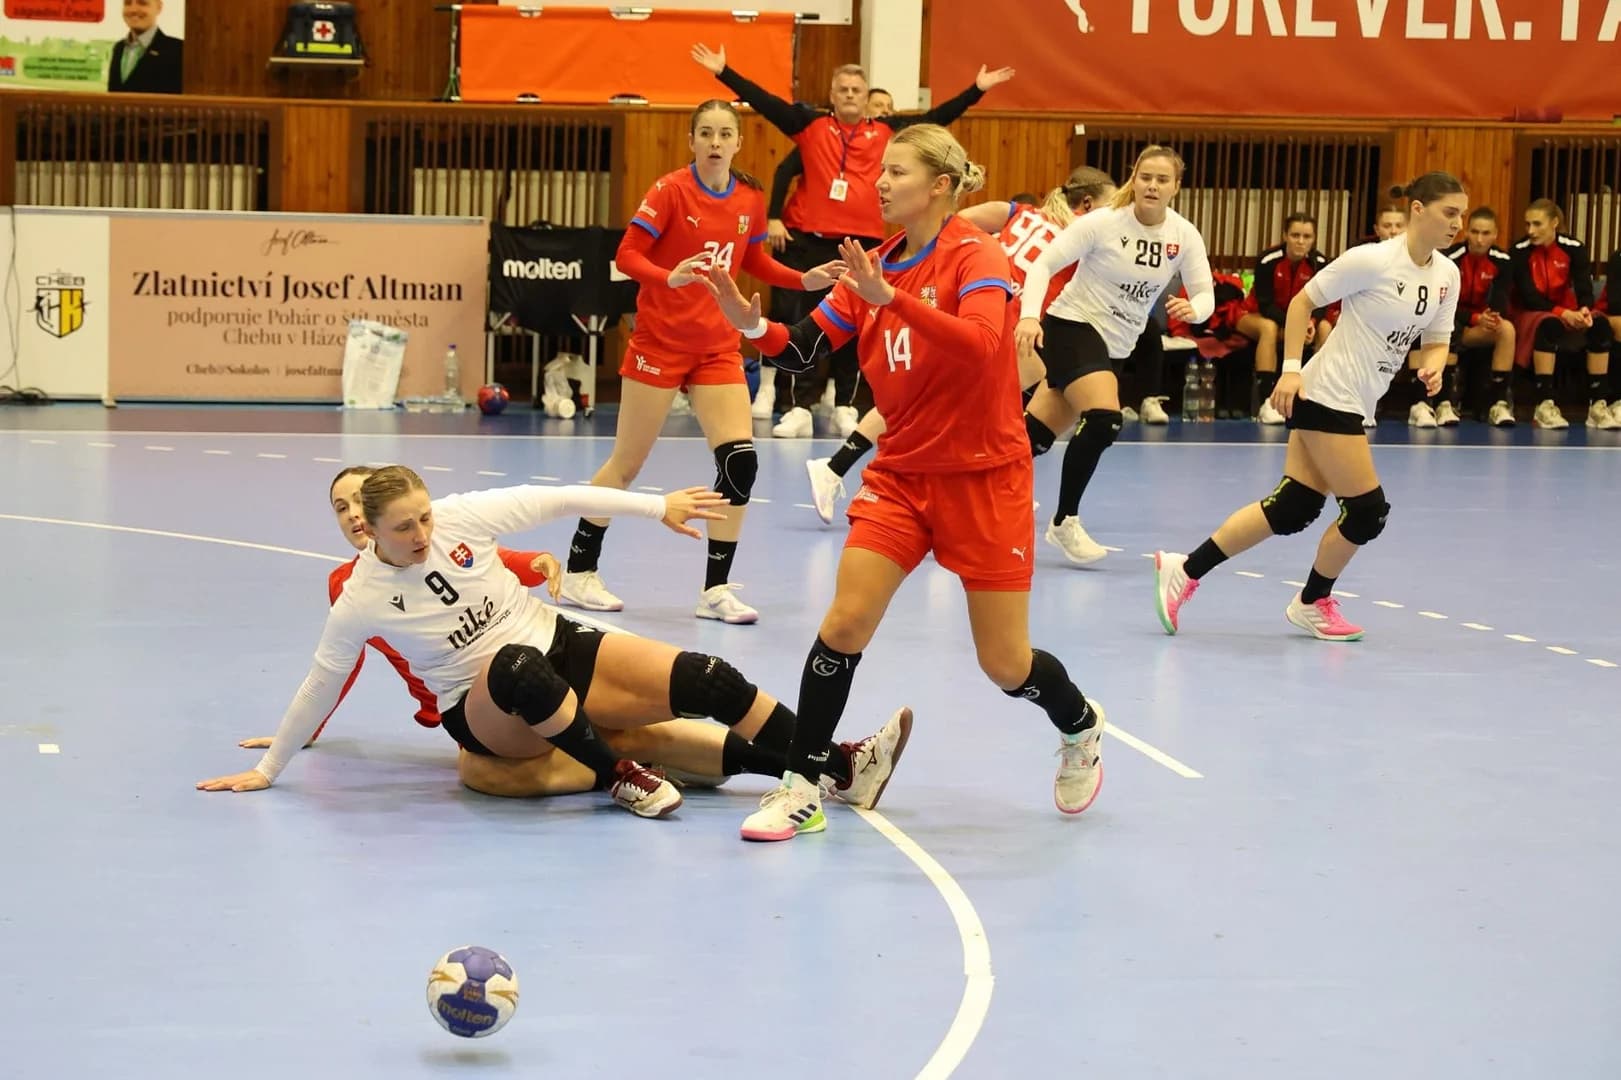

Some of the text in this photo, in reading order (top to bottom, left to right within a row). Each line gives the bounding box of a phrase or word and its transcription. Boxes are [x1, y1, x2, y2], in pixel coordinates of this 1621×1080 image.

[1001, 210, 1060, 273] 98
[1135, 239, 1162, 268] 28
[503, 258, 582, 280] molten
[704, 241, 735, 273] 34
[35, 276, 85, 286] CHEB
[132, 270, 463, 304] Zlatnictví Josef Altman
[1415, 286, 1428, 315] 8
[167, 307, 262, 328] podporuje
[268, 308, 318, 326] Pohár
[325, 315, 336, 326] o
[223, 327, 347, 347] Chebu v Háze
[884, 327, 911, 372] 14
[425, 571, 459, 606] 9
[446, 595, 498, 649] niké
